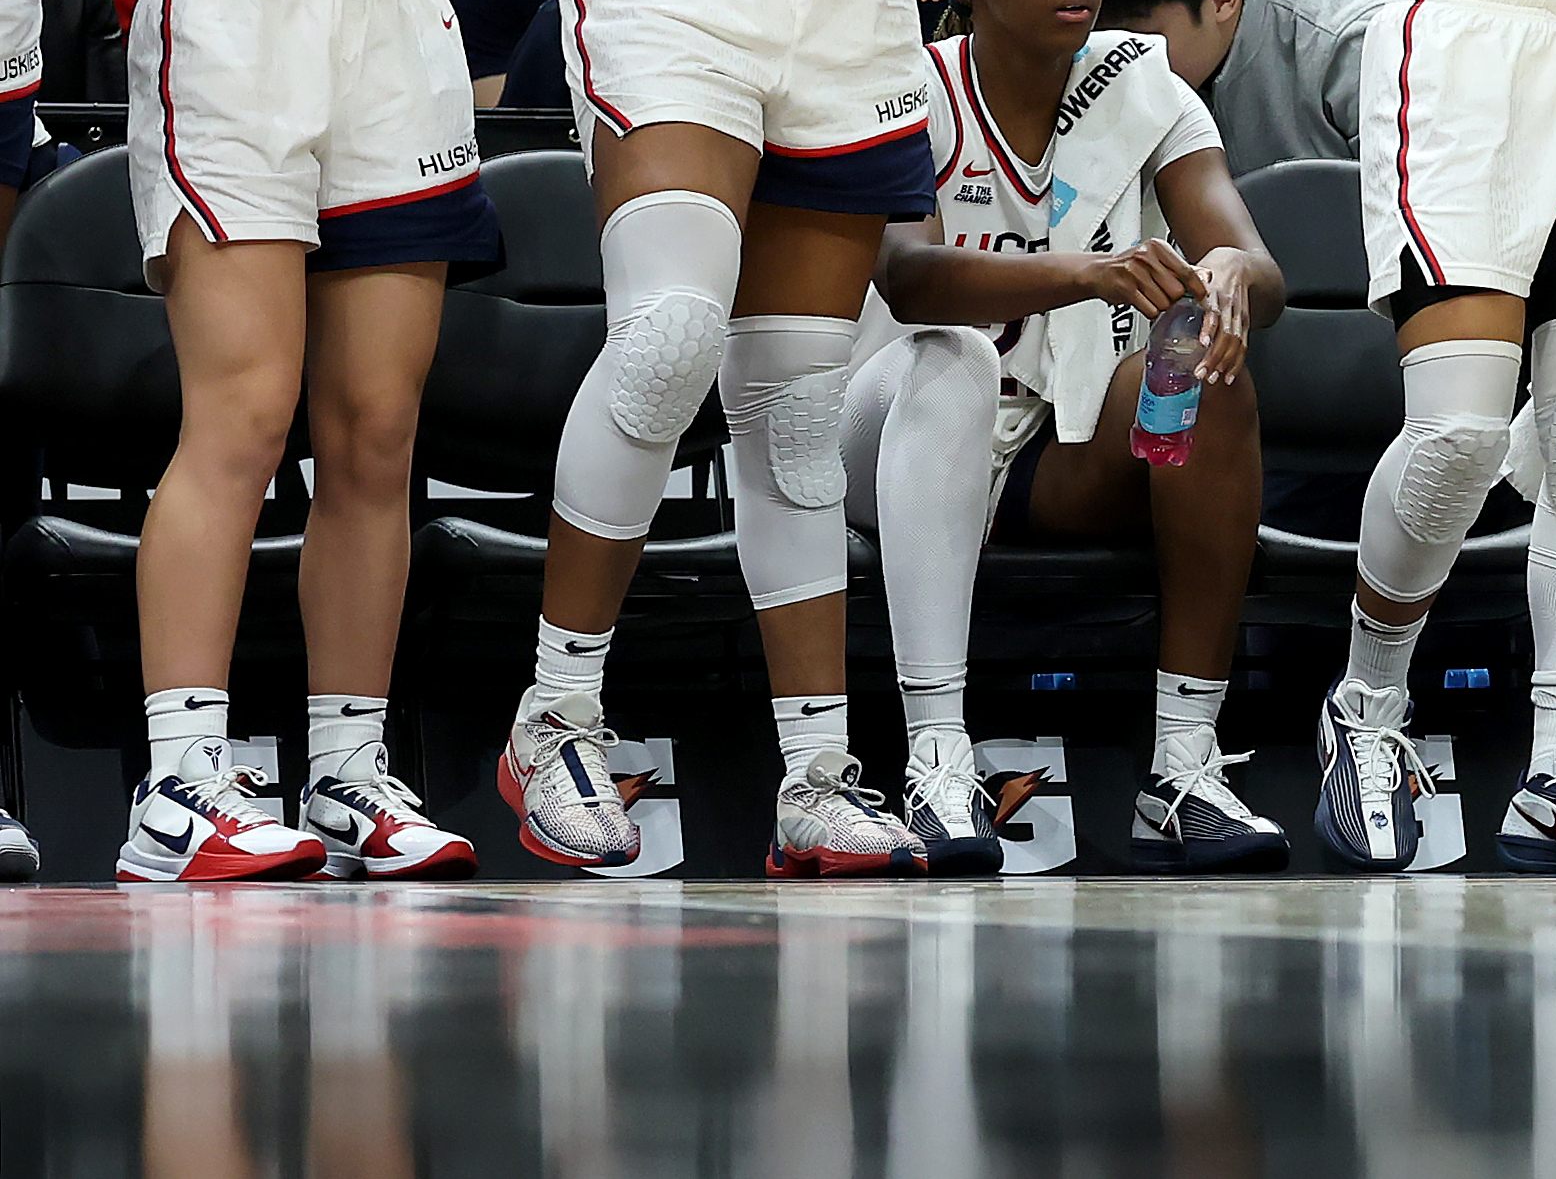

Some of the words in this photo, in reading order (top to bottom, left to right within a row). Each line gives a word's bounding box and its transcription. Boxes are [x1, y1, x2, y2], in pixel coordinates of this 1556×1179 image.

[960, 184, 974, 195] BE
[976, 185, 992, 196] THE
[954, 193, 994, 206] CHANGE
